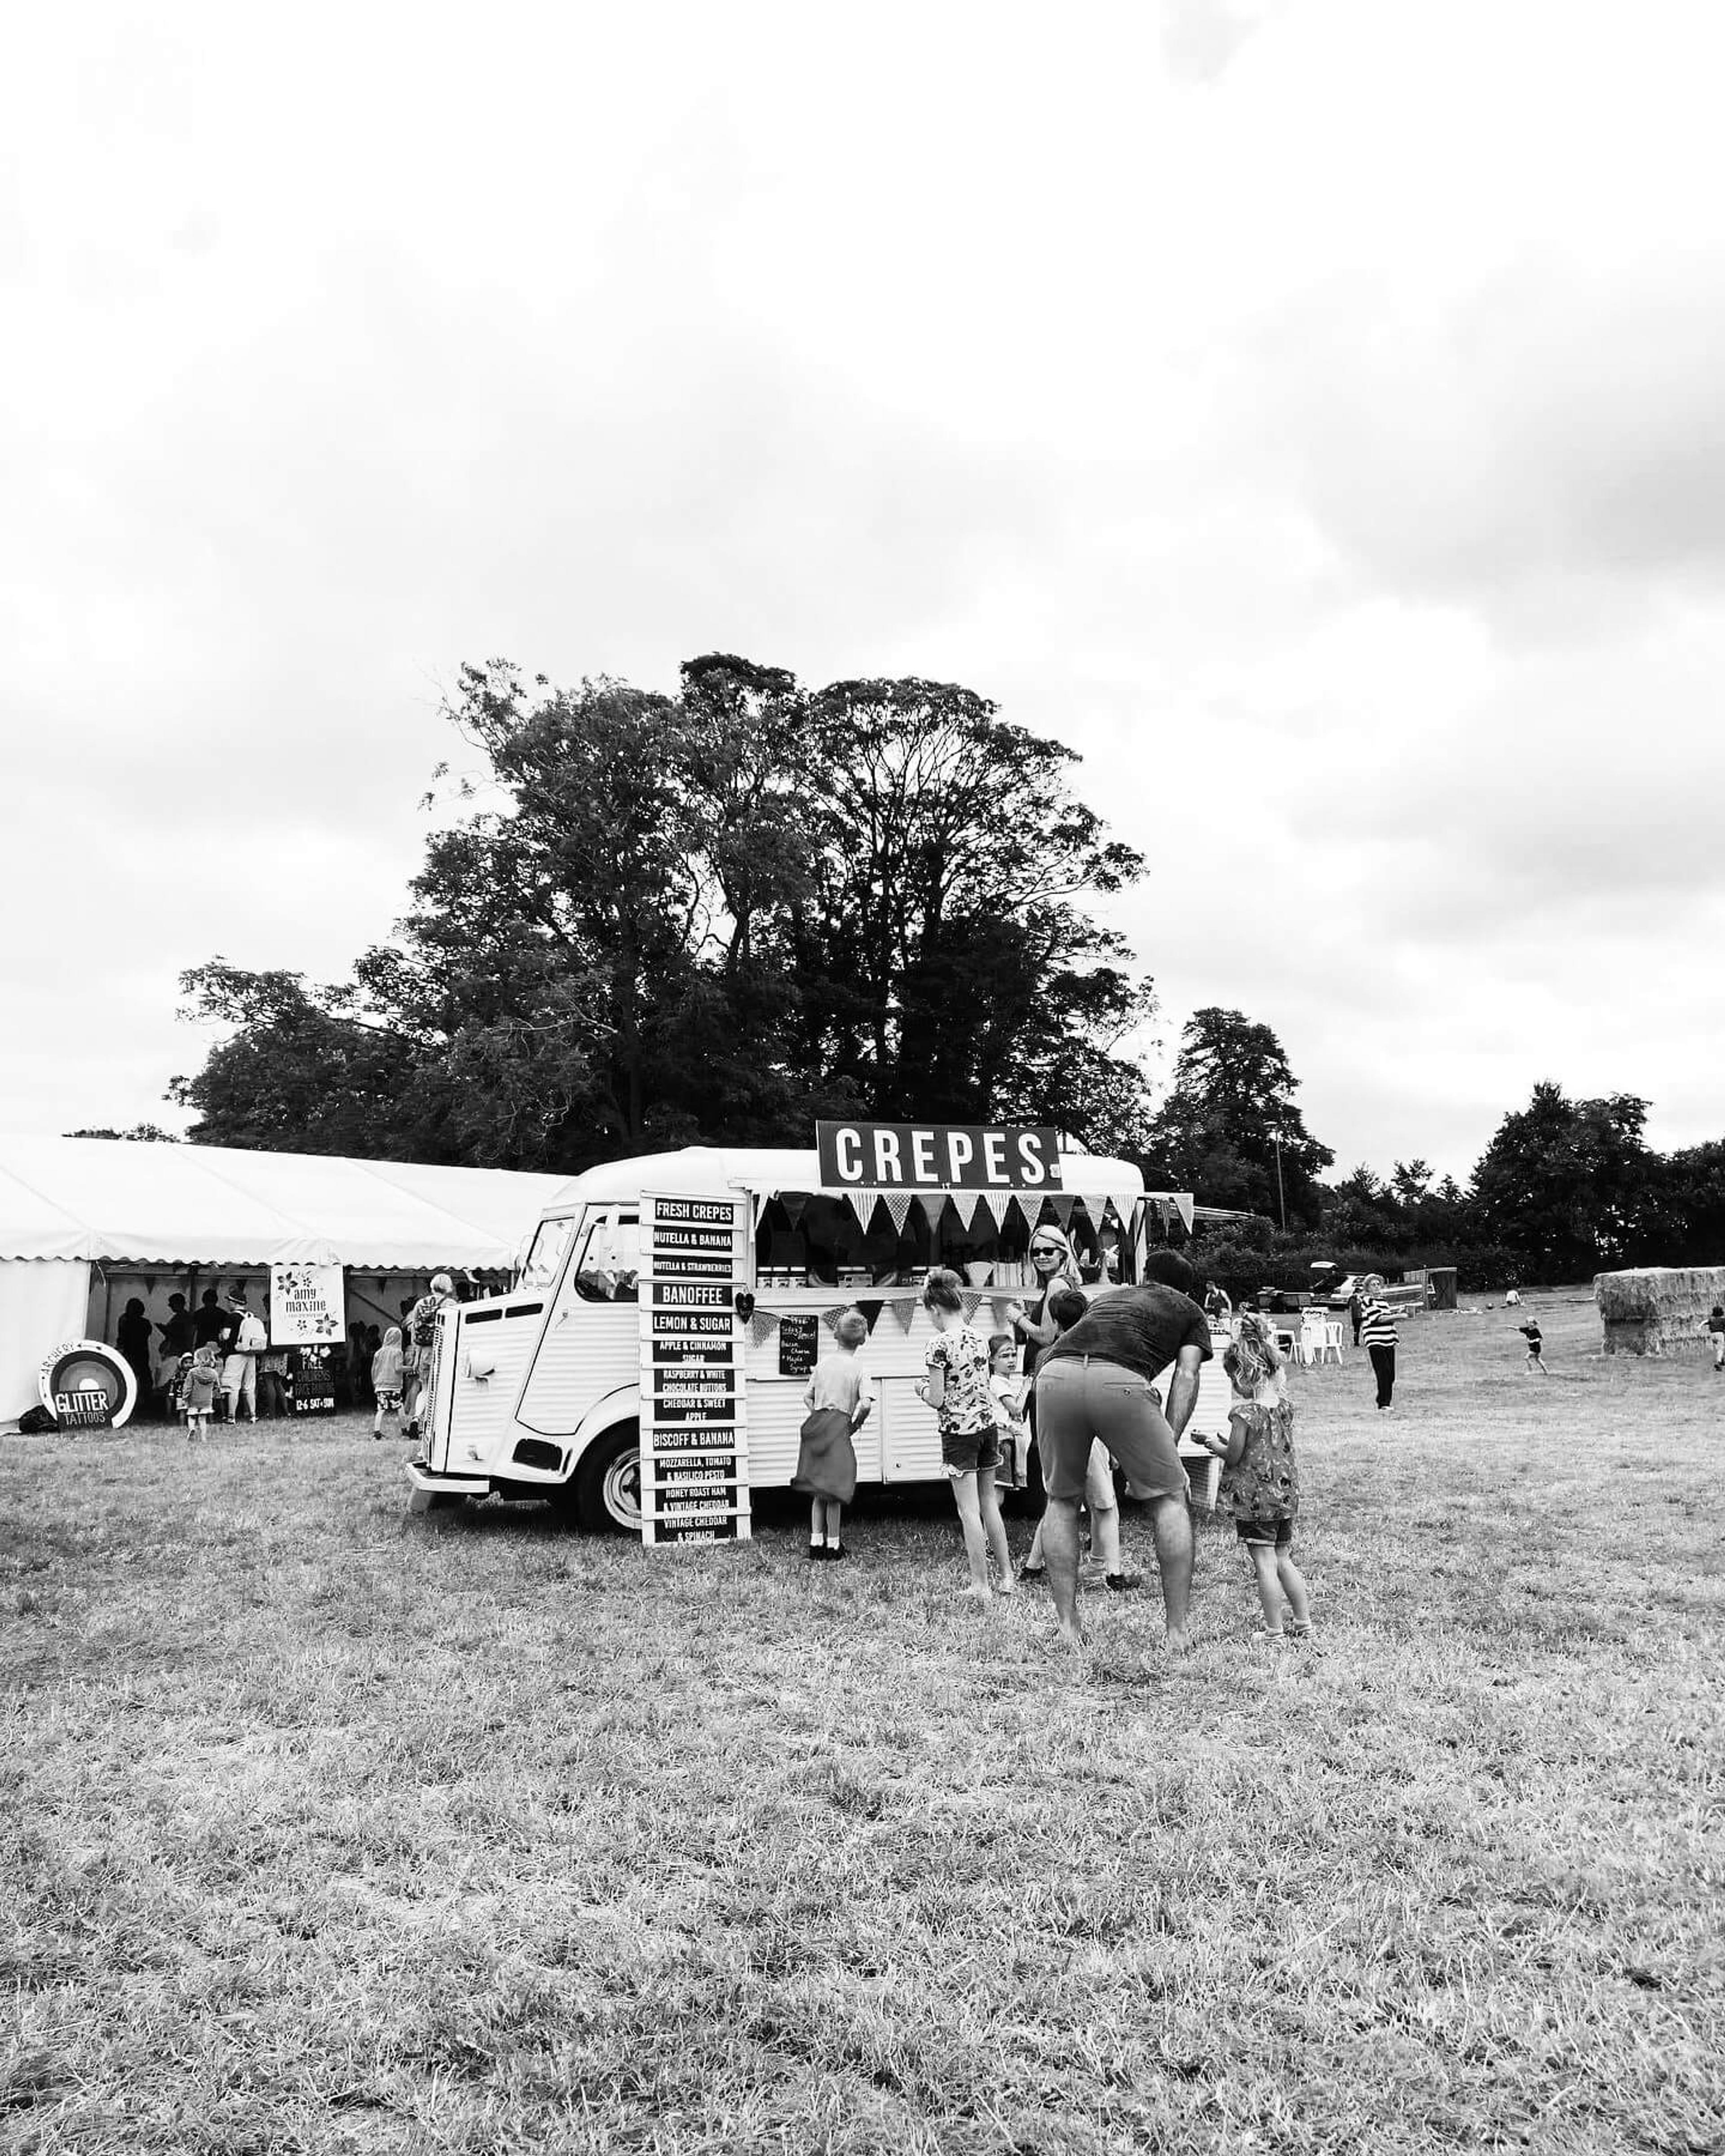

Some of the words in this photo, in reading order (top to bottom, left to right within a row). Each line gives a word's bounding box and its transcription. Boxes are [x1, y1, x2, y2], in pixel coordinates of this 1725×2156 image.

[836, 1128, 1044, 1184] CREPES
[657, 1202, 690, 1218] FRESH
[692, 1205, 732, 1220] CREPES
[654, 1231, 689, 1245] NUTELLA
[691, 1233, 697, 1245] &
[699, 1234, 732, 1247] BANANA
[653, 1261, 680, 1271] NUTELLA
[681, 1262, 686, 1271] &
[687, 1263, 732, 1273] STRAWBERRIES
[294, 1288, 316, 1300] amy
[663, 1286, 723, 1304] BANOFFEE
[286, 1300, 326, 1313] maxine
[654, 1316, 687, 1330] LEMON
[690, 1317, 698, 1330] &
[699, 1317, 731, 1331] SUGAR
[660, 1341, 681, 1350] APPLE
[683, 1341, 688, 1350] &
[690, 1341, 727, 1351] CINNAMON
[40, 1341, 75, 1375] ARCHERY
[682, 1354, 705, 1362] SUGAR
[663, 1370, 699, 1379] RASPBERRY
[700, 1370, 705, 1379] &
[706, 1370, 726, 1379] WHITE
[663, 1383, 699, 1392] CHOCOLATE
[700, 1383, 726, 1392] BUTTONS
[55, 1391, 109, 1413] GLITTER
[663, 1399, 695, 1409] CHEDDAR
[697, 1399, 702, 1408] &
[703, 1399, 726, 1408] SWEET
[64, 1411, 106, 1425] TATTOOS
[685, 1412, 708, 1421] APPLE
[654, 1433, 689, 1447] BISCOFF
[691, 1433, 698, 1446] &
[699, 1431, 734, 1445] BANANA
[660, 1458, 703, 1468] MOZZARELLA,
[705, 1457, 732, 1467] TOMATO
[667, 1471, 672, 1481] &
[674, 1471, 703, 1481] BASILICO
[704, 1470, 725, 1480] PESTO
[666, 1488, 688, 1498] HONEY
[690, 1487, 710, 1498] ROAST
[712, 1486, 726, 1496] HAM
[663, 1502, 668, 1512] &
[670, 1502, 698, 1512] VINTAGE
[699, 1499, 730, 1510] CHEDDAR
[664, 1518, 694, 1529] VINTAGE
[695, 1516, 728, 1527] CHEDDAR
[678, 1532, 683, 1542] &
[685, 1530, 715, 1542] SPINACH
